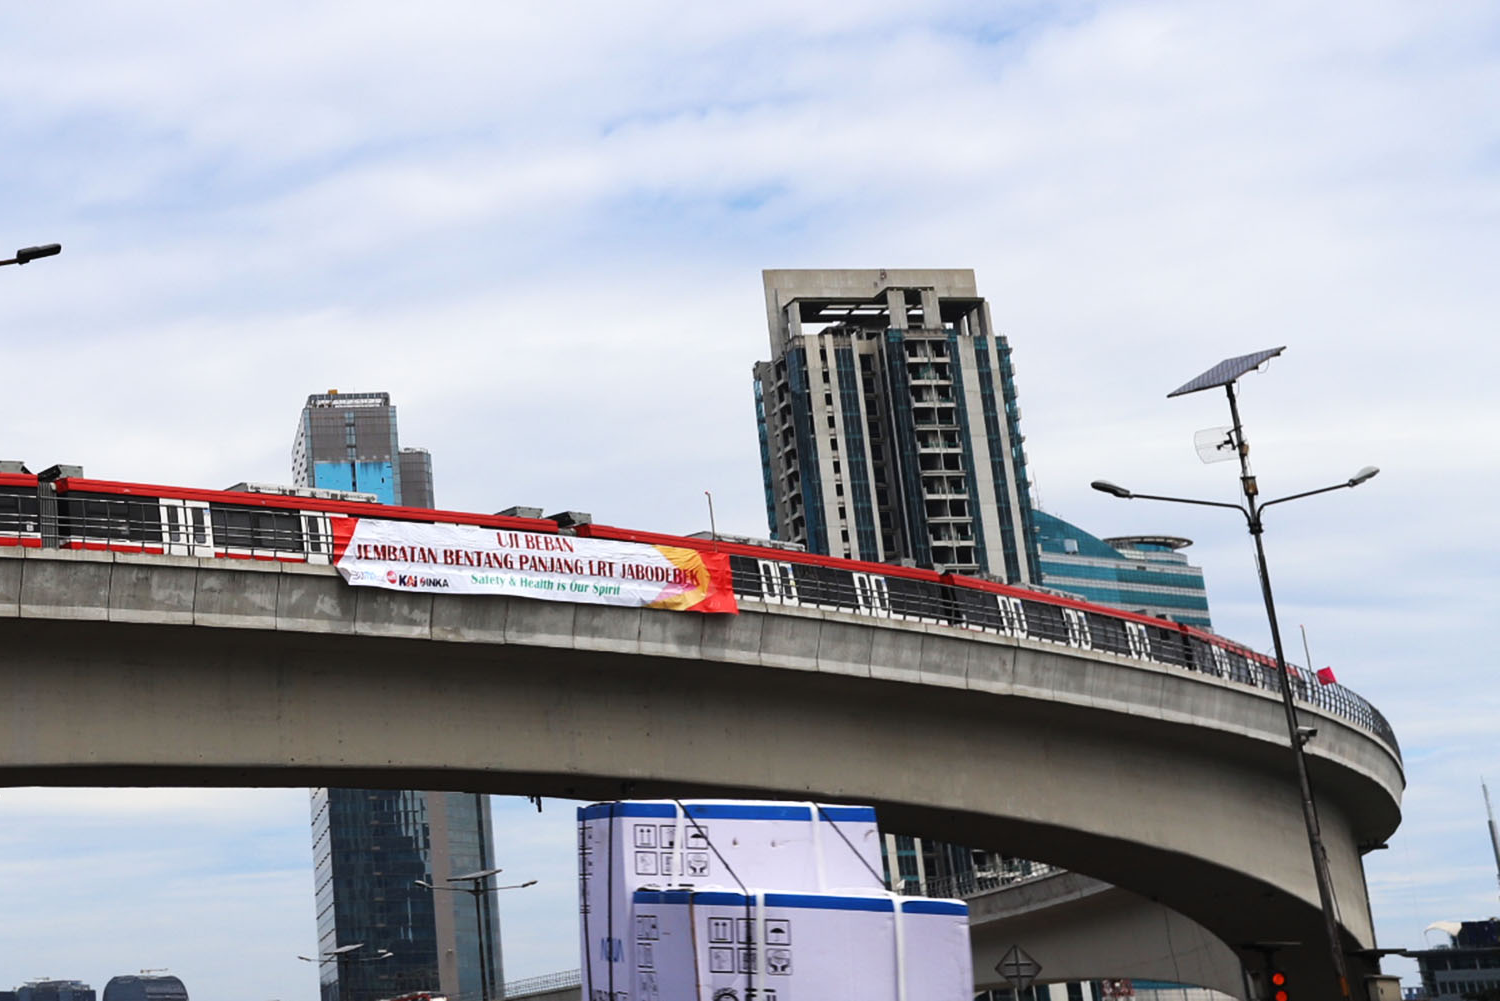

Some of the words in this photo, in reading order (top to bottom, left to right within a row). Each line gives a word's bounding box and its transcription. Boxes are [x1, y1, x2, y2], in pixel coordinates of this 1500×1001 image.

[496, 532, 519, 549] UJI
[525, 534, 574, 553] BEBAN
[355, 544, 438, 564] JEMBATAN
[443, 549, 514, 569] BENTANG
[519, 555, 584, 576] PANJANG
[589, 560, 615, 578] LRT
[620, 564, 699, 586] JABODEBEK
[471, 574, 506, 587] Safety
[509, 577, 517, 587] &
[520, 577, 554, 591] Health
[556, 580, 566, 591] is
[570, 580, 589, 593] Our
[592, 582, 620, 596] Spirit
